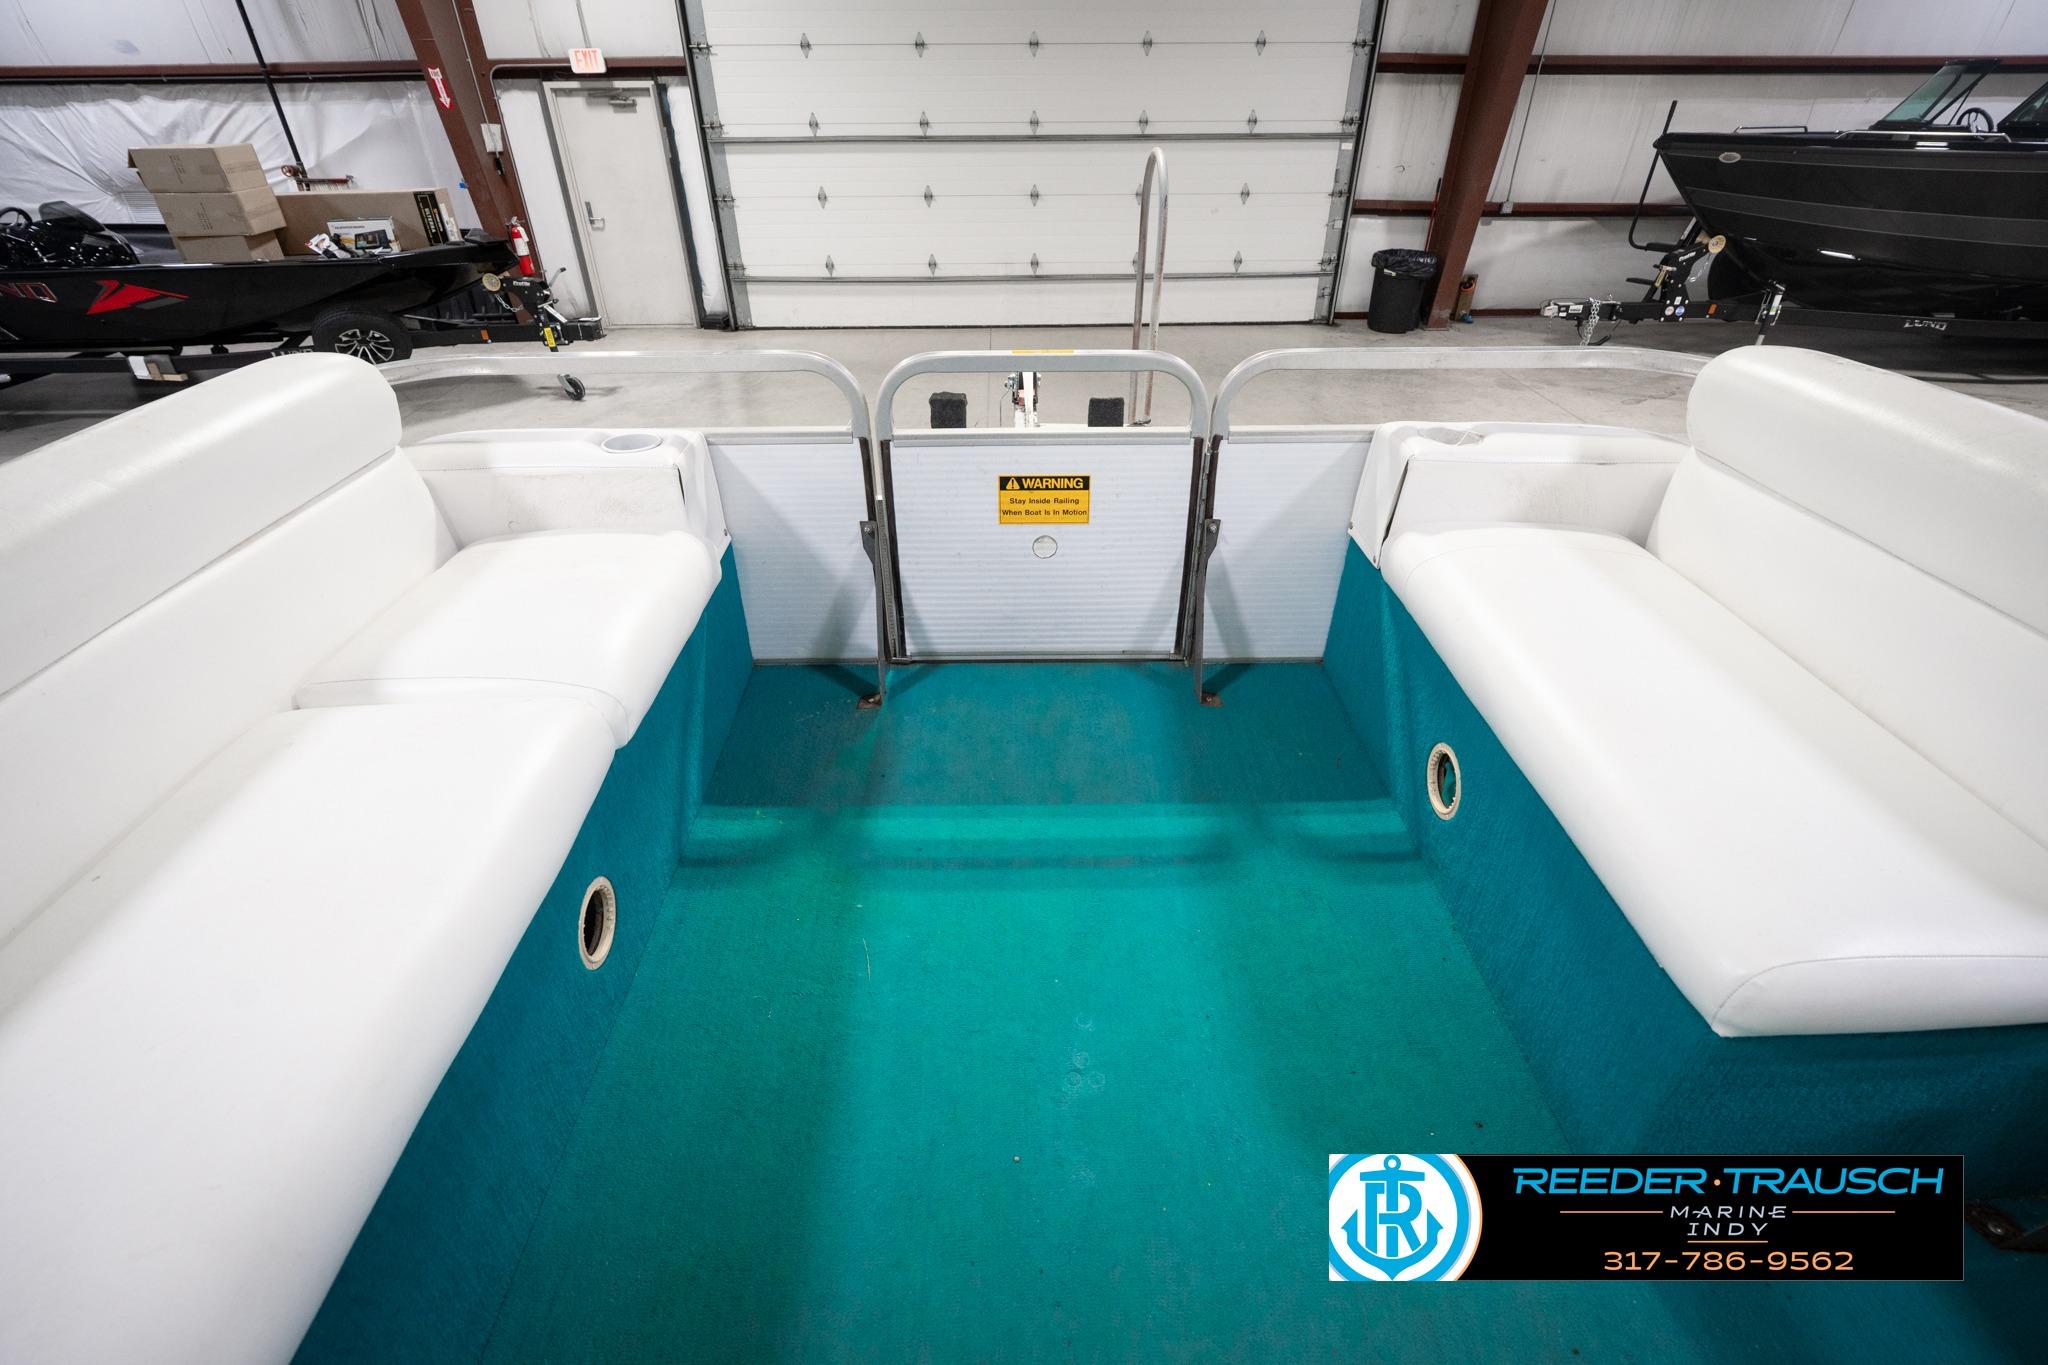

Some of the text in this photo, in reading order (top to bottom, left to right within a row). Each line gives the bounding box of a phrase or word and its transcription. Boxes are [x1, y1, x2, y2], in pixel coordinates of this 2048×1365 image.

[574, 50, 599, 67] EXIT
[1022, 477, 1084, 489] WARNING
[1009, 497, 1026, 505] Stay
[1053, 497, 1080, 505] Railing
